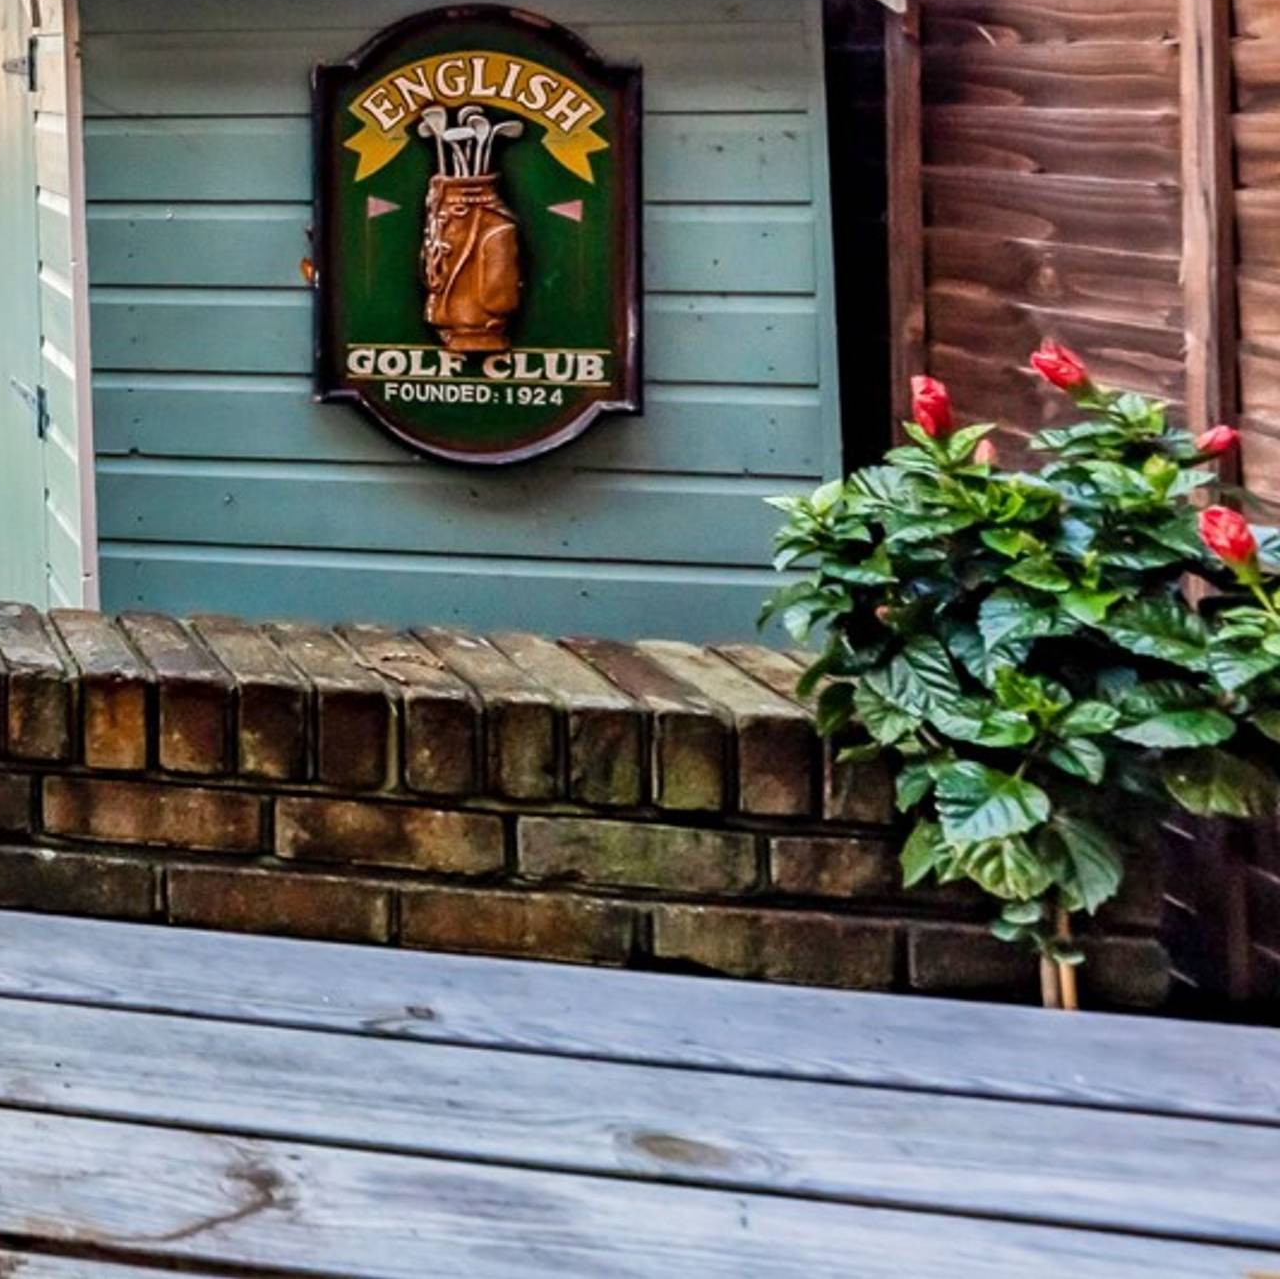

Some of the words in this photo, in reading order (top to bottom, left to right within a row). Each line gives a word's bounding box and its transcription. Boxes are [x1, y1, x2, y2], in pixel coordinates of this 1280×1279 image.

[362, 57, 592, 132] ENGLISH
[346, 348, 466, 378] GOLF
[482, 353, 605, 382] CLUB
